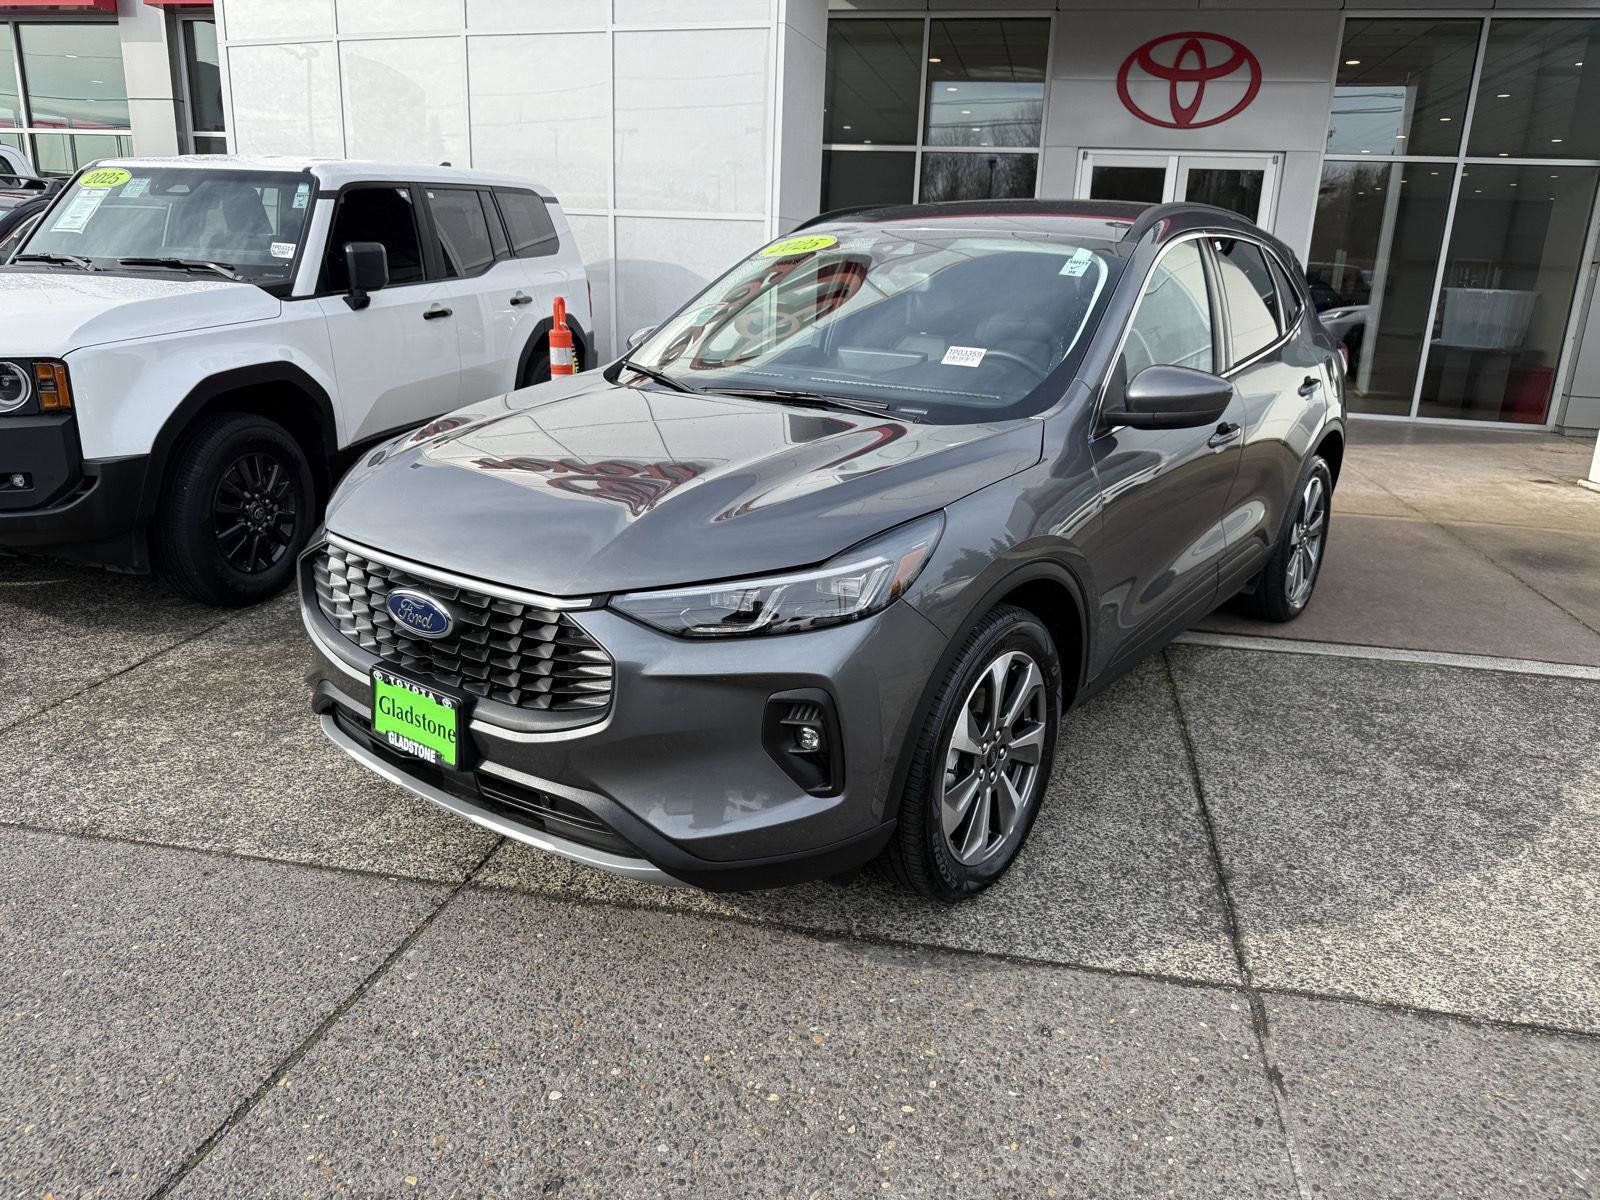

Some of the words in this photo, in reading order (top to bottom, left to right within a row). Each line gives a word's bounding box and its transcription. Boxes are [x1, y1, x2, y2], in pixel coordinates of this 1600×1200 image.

[83, 172, 125, 184] 2025
[397, 598, 434, 629] Ford
[387, 674, 437, 703] TOYOTA
[378, 695, 457, 744] Gladstone
[387, 731, 437, 764] GLADSTONE
